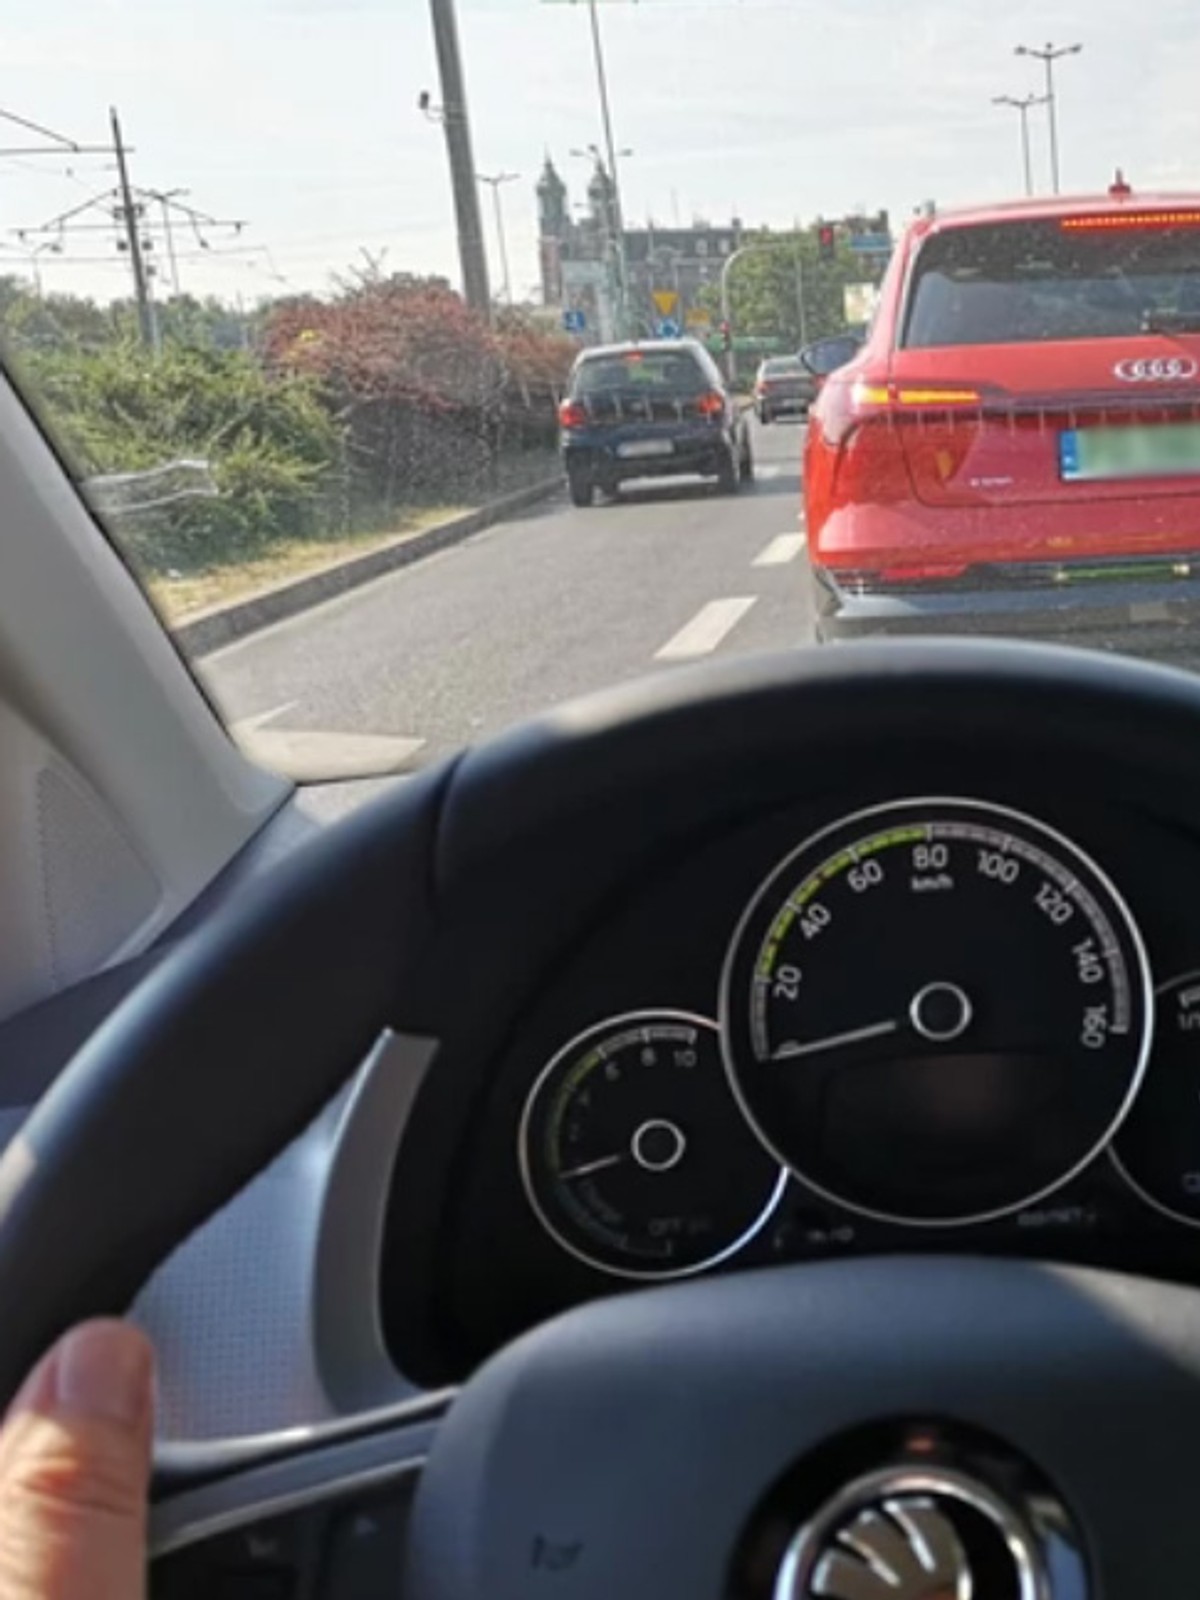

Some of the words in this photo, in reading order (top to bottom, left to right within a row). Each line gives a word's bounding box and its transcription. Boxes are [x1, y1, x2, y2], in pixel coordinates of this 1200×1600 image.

[912, 845, 948, 868] 80
[977, 850, 1020, 884] 100
[848, 861, 883, 892] 60
[800, 903, 832, 939] 40
[1035, 883, 1074, 925] 120
[1073, 937, 1103, 983] 140
[774, 965, 802, 1000] 20
[1081, 1005, 1107, 1048] 160
